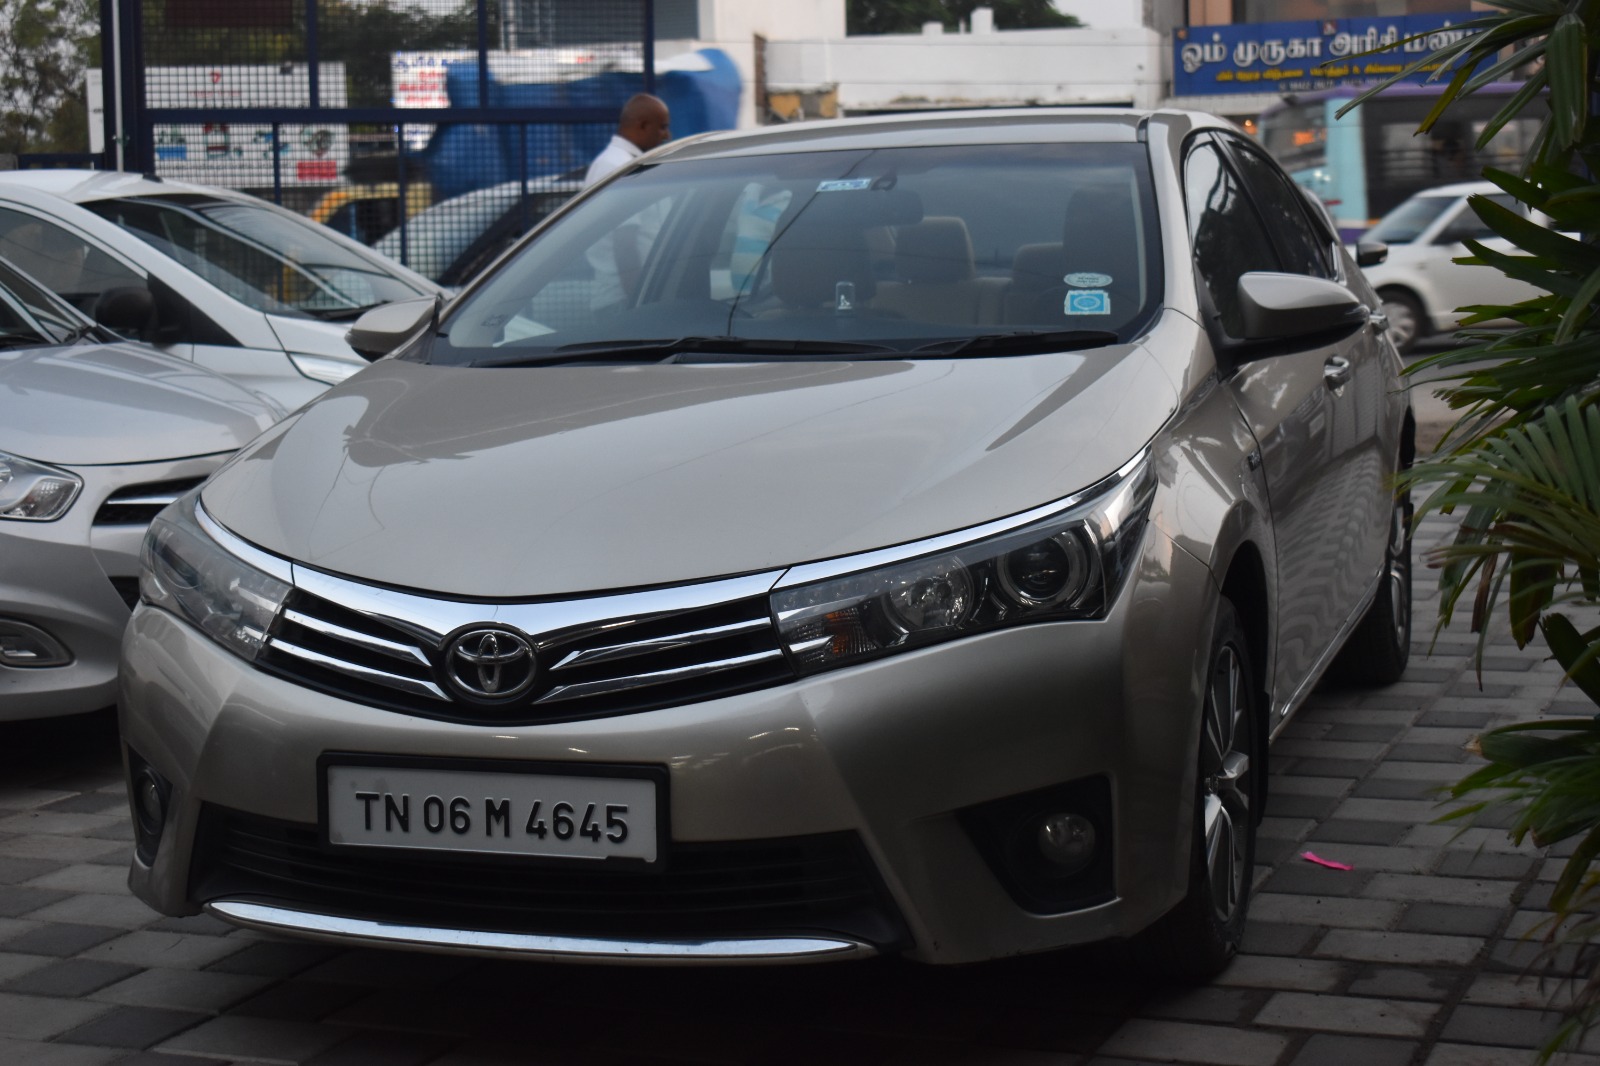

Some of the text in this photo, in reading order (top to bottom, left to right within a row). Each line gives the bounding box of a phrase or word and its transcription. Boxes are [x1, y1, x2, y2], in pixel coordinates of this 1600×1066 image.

[1181, 32, 1227, 73] ஓம்
[1233, 38, 1322, 67] முருகா
[1329, 26, 1398, 56] அரிசி
[355, 791, 629, 844] TN 06 M 4645
